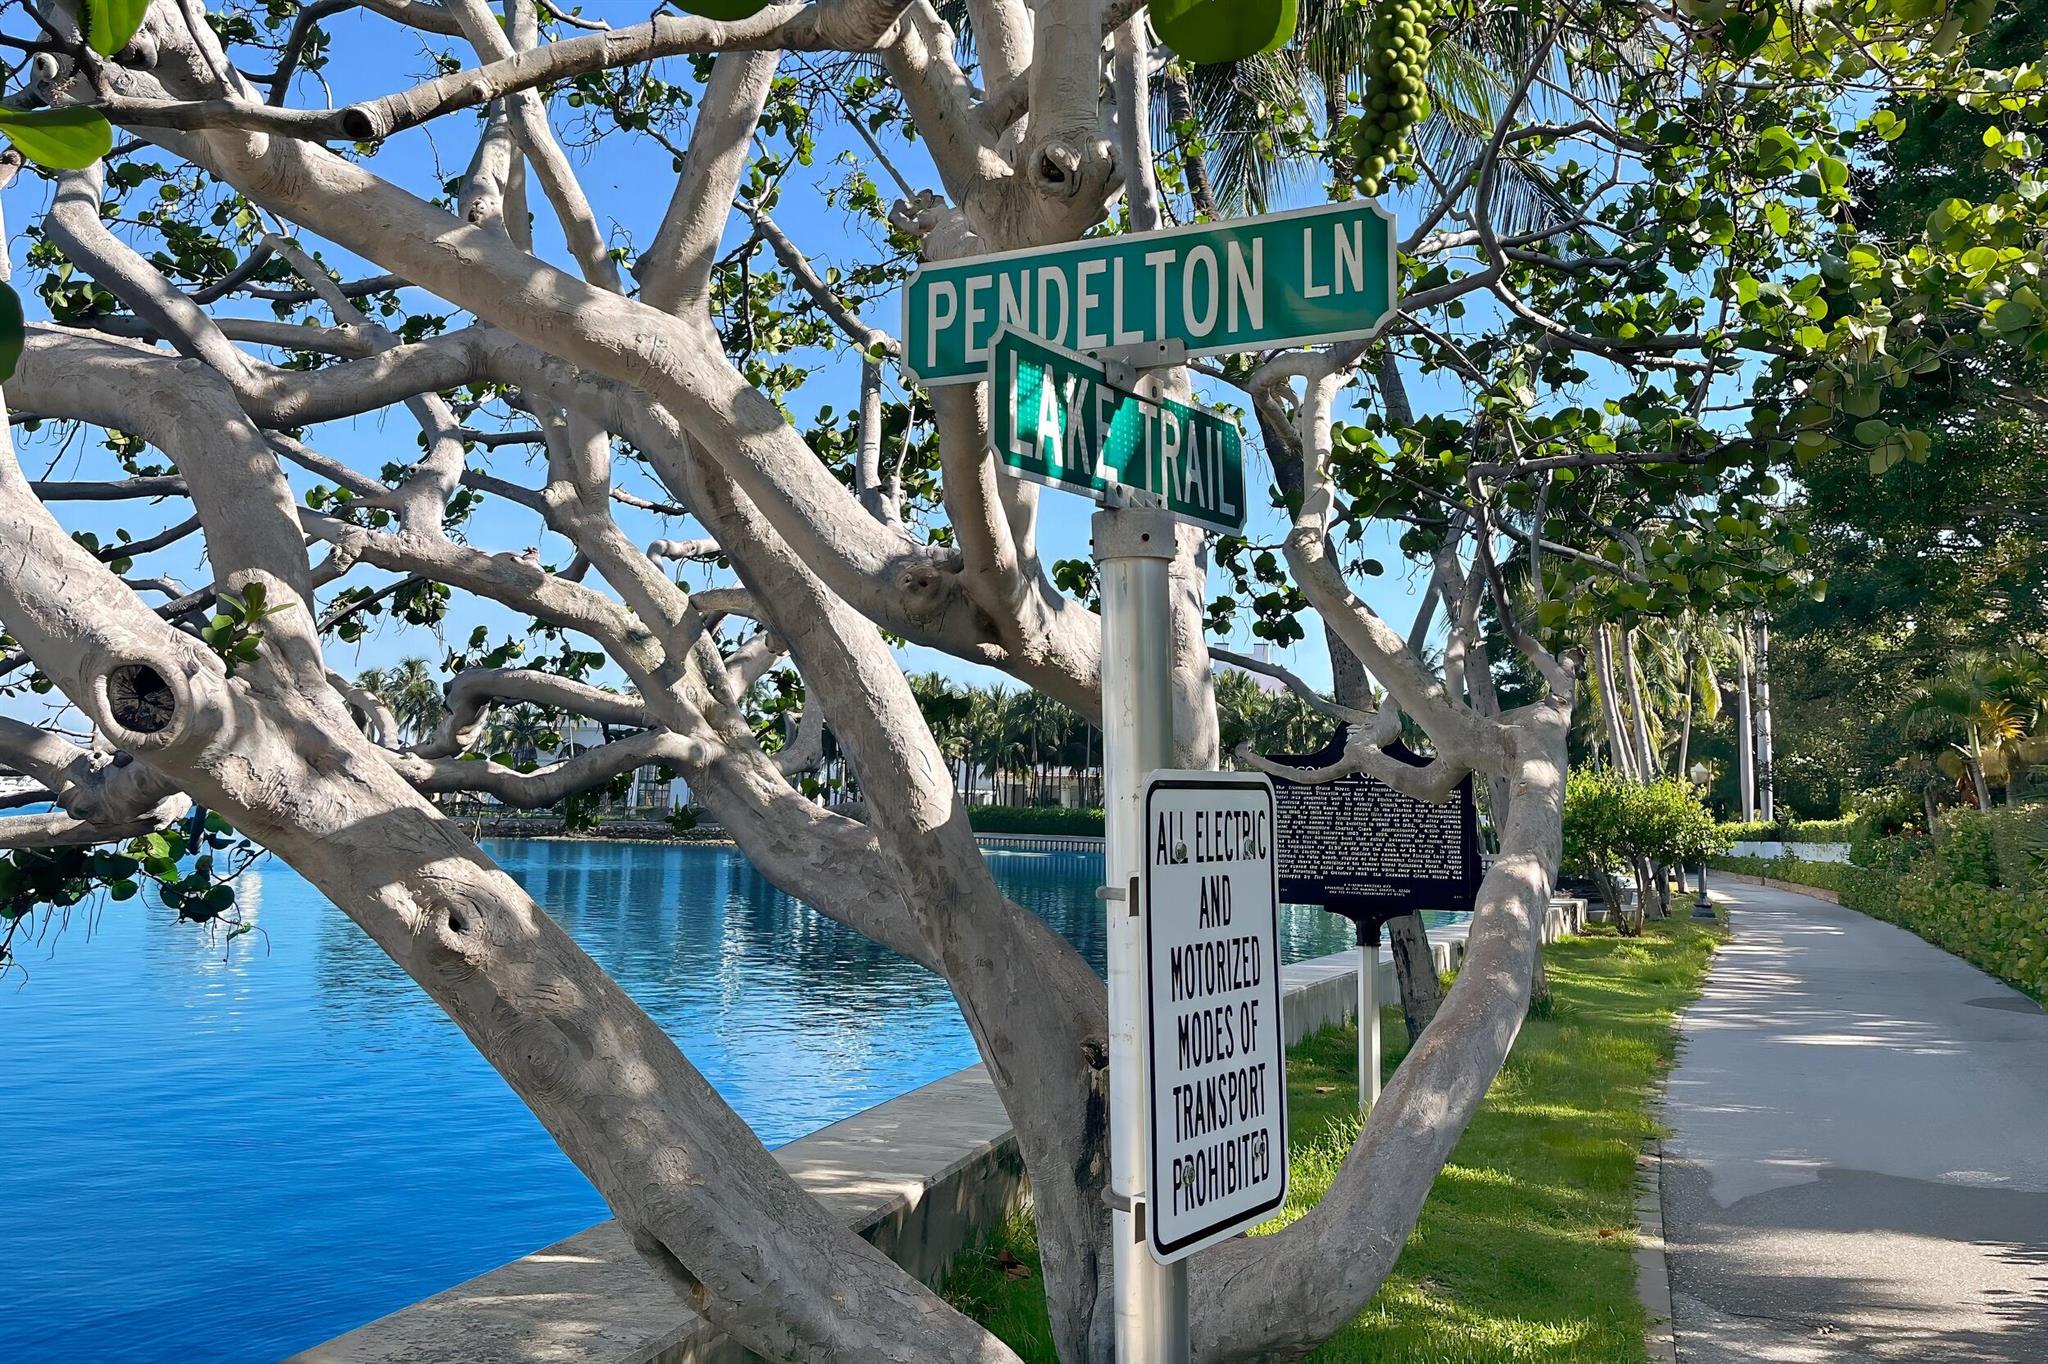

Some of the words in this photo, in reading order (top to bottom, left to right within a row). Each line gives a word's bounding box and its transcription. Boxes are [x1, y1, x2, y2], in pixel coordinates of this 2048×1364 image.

[927, 237, 1264, 368] PENDELTON
[1303, 219, 1364, 299] LN
[1009, 350, 1119, 482] LAKE
[1138, 401, 1236, 517] TRAIL
[1156, 811, 1189, 865] ALL
[1196, 810, 1267, 863] ELECTRIC
[1199, 875, 1232, 929] AND
[1170, 936, 1261, 1002] MOTORIZED
[1178, 1004, 1234, 1071] MODES
[1240, 1000, 1259, 1055] OF
[1173, 1063, 1266, 1143] TRANSPORT
[1173, 1128, 1270, 1217] PROHIBITED
